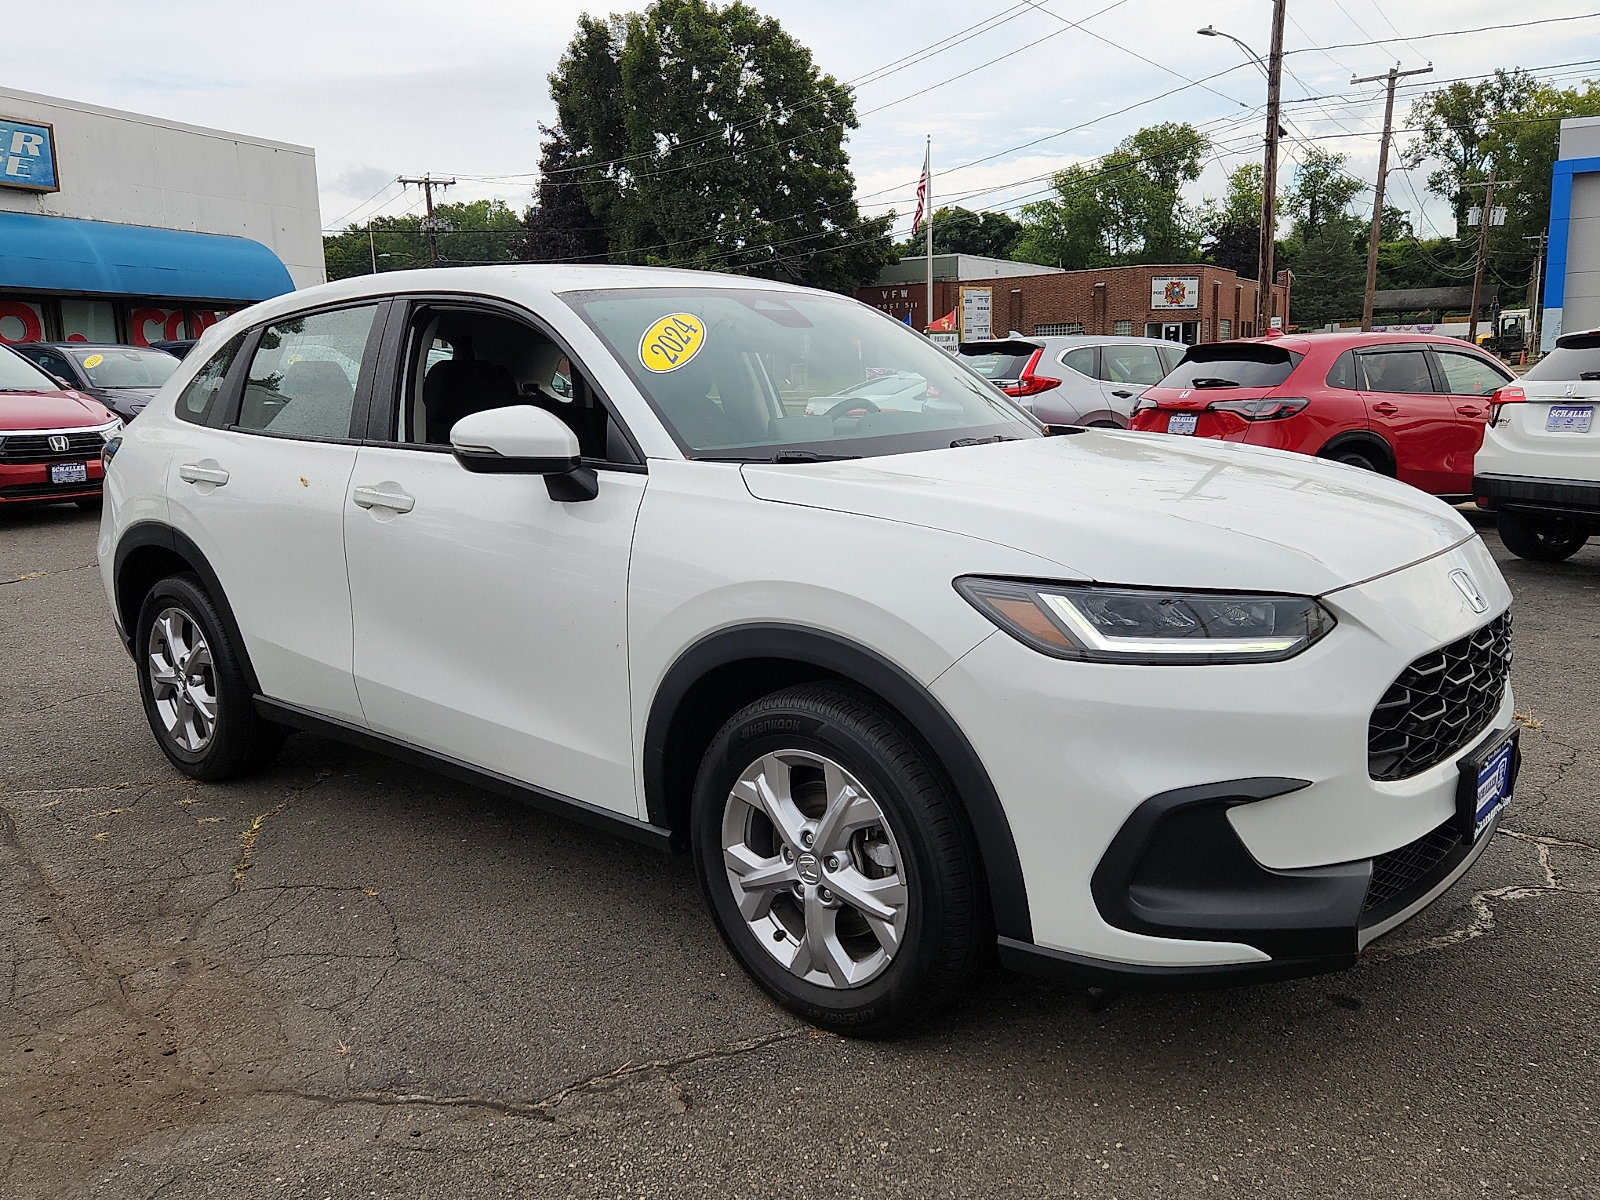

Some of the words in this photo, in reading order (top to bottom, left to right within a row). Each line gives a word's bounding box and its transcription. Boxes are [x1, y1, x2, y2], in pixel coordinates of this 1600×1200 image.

[0, 155, 35, 178] E
[881, 289, 909, 300] VFW
[877, 302, 900, 310] POST
[904, 301, 919, 309] 511
[650, 317, 698, 364] 2024
[1549, 409, 1592, 418] SCHALLER
[51, 464, 86, 473] SCHALLER
